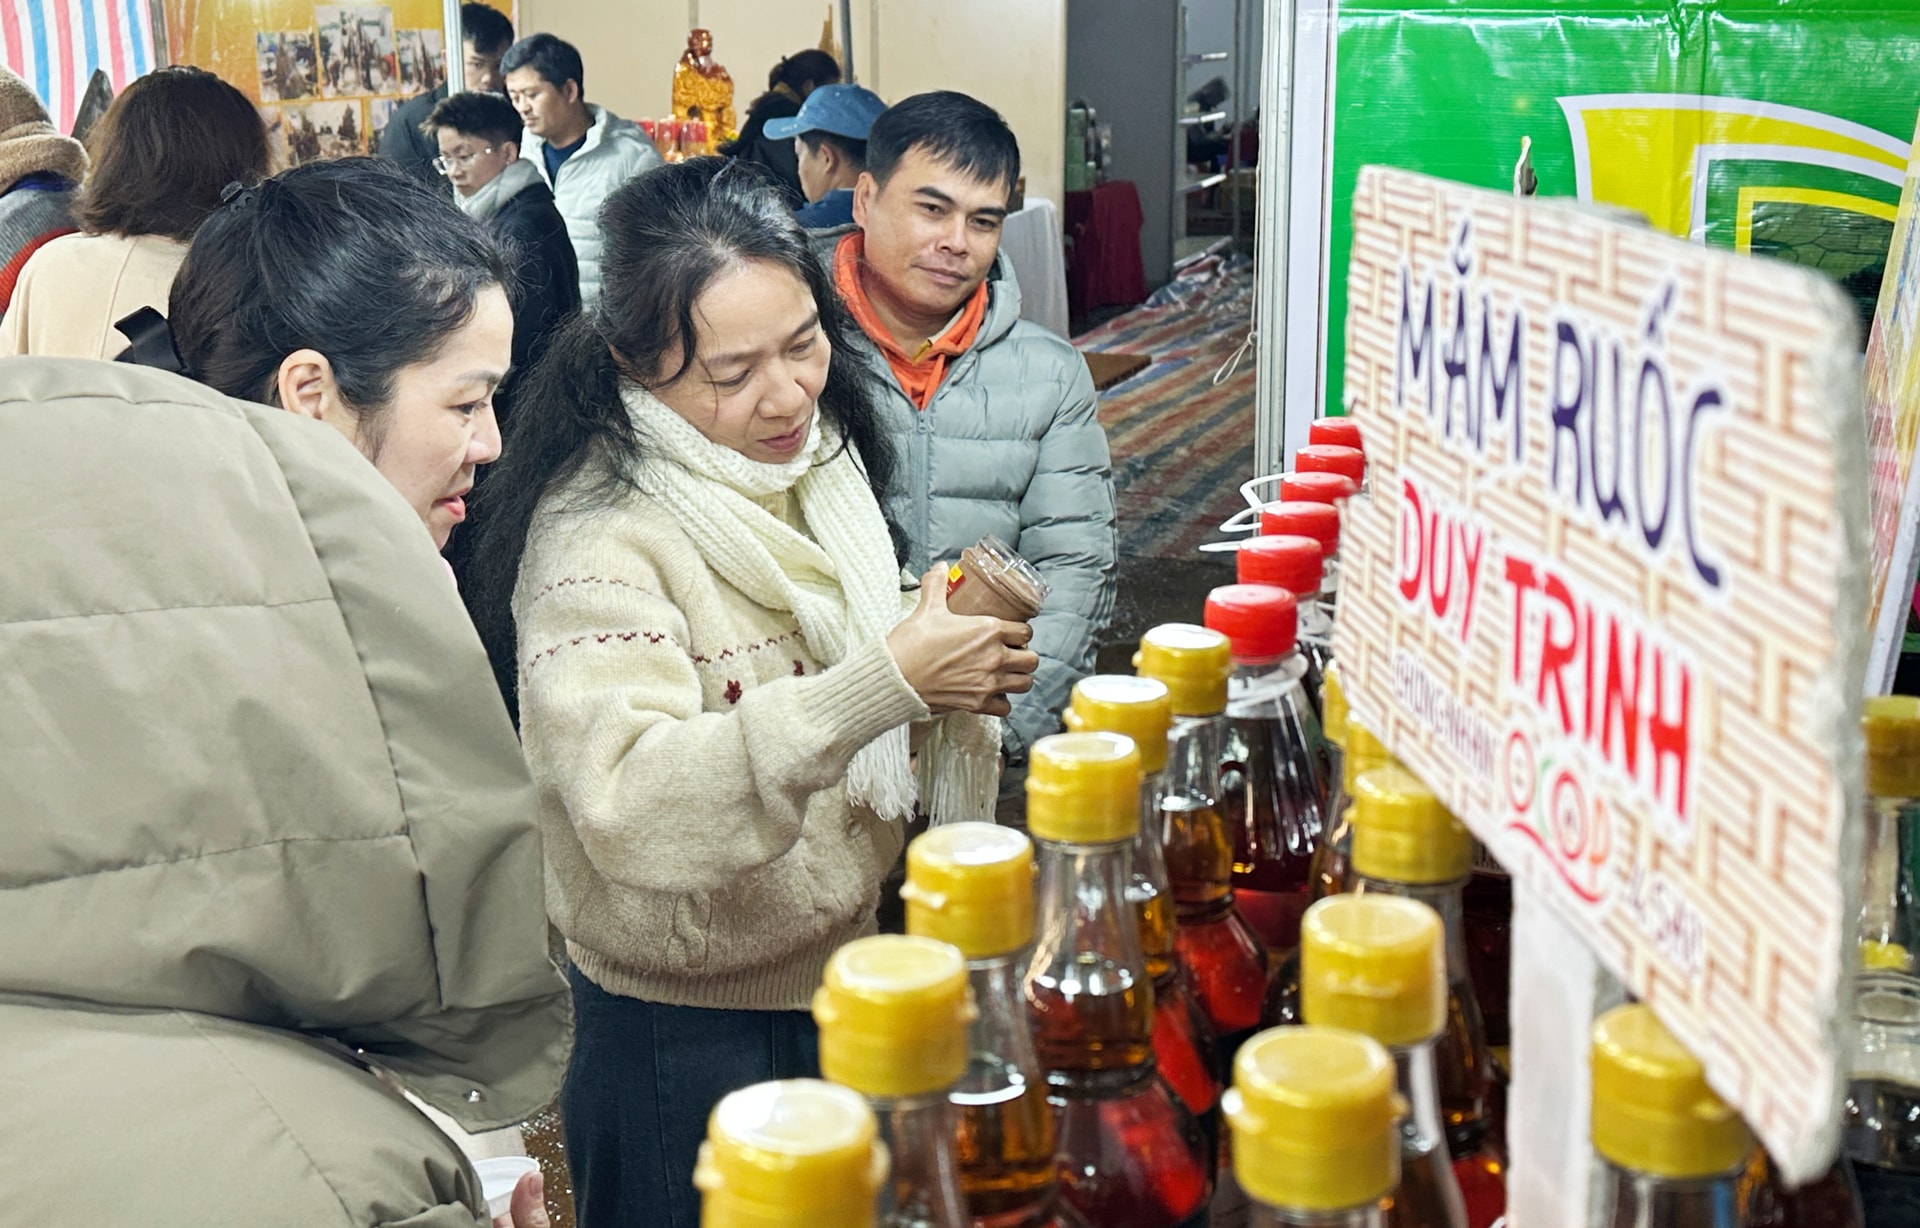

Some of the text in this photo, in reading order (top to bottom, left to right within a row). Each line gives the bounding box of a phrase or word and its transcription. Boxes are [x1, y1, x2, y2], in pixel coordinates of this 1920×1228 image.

[1397, 220, 1723, 588] MẮM RUỐC
[1398, 478, 1692, 825] DUY TRINH
